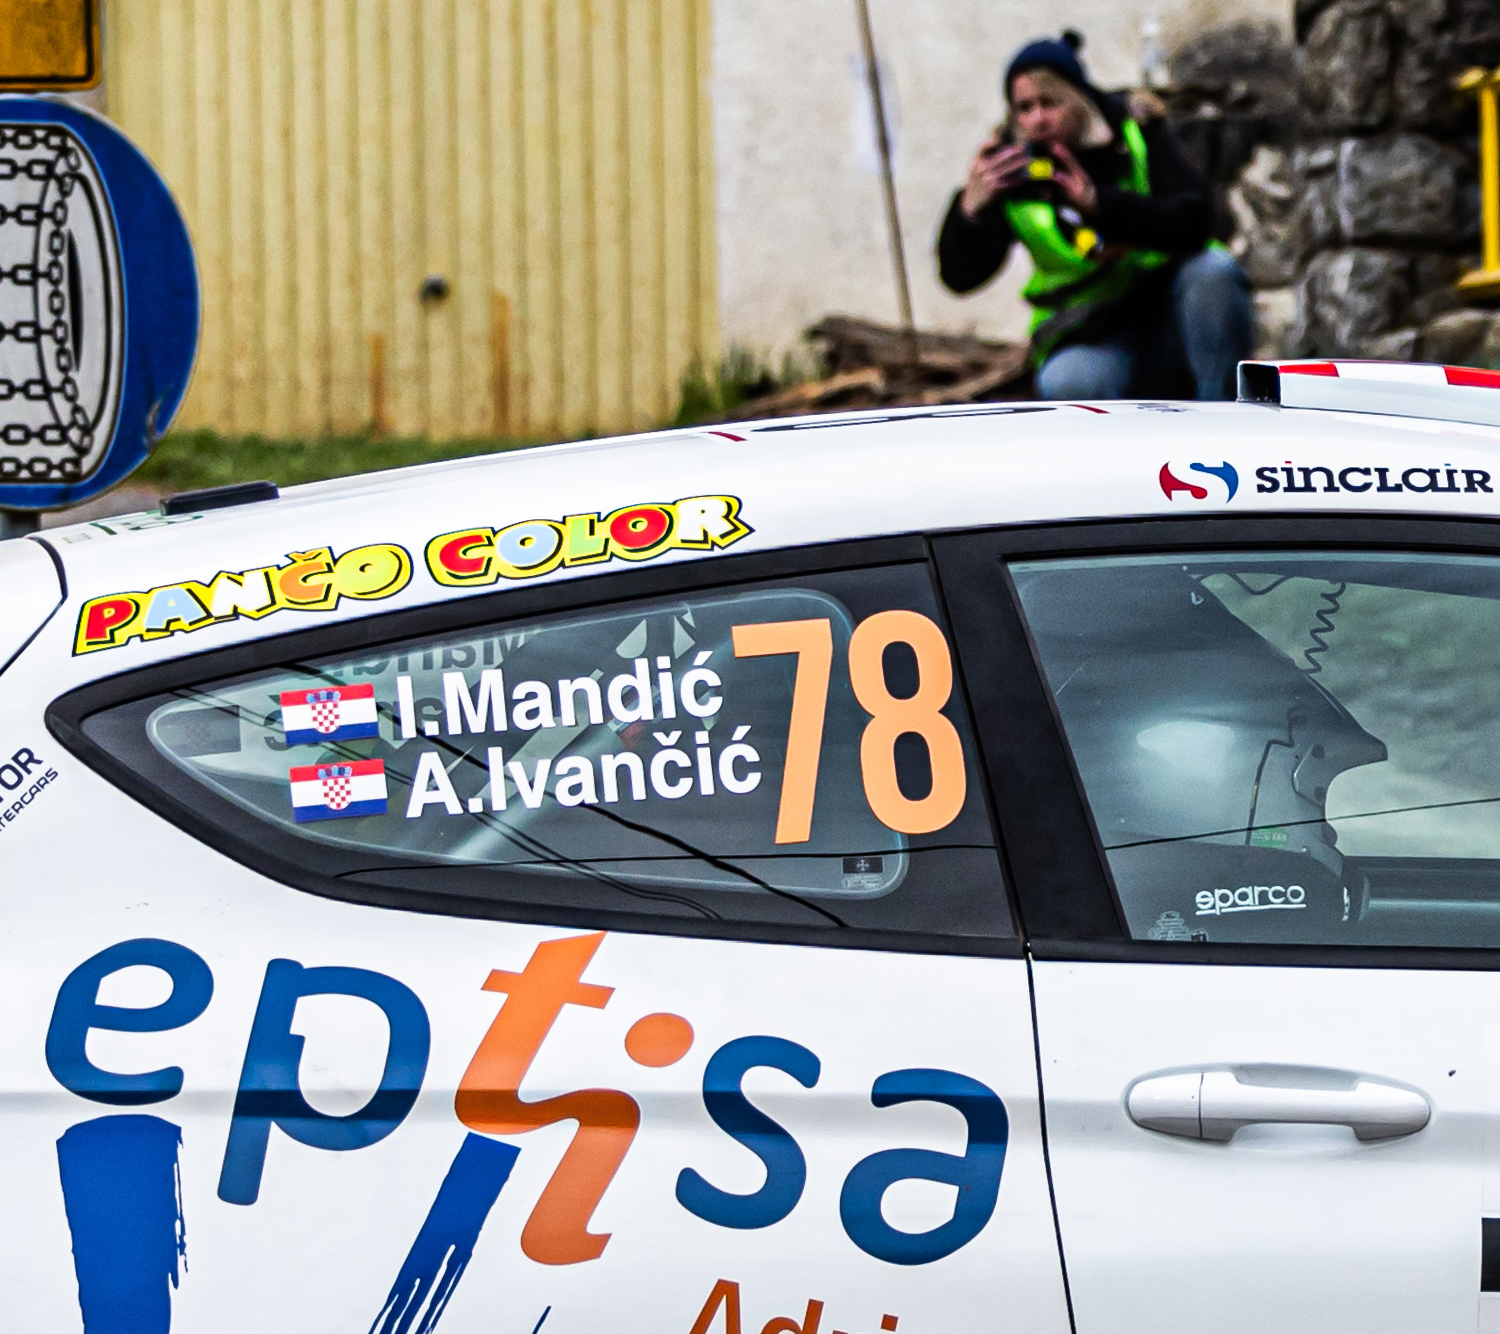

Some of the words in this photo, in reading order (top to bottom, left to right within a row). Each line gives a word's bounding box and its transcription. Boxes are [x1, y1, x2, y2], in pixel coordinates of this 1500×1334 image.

[72, 545, 413, 657] PANČO
[425, 494, 755, 587] COLOR
[397, 651, 724, 740] I.Mandić
[731, 609, 968, 844] 78
[406, 724, 763, 819] A.Ivančić
[46, 930, 1009, 1265] eptisa
